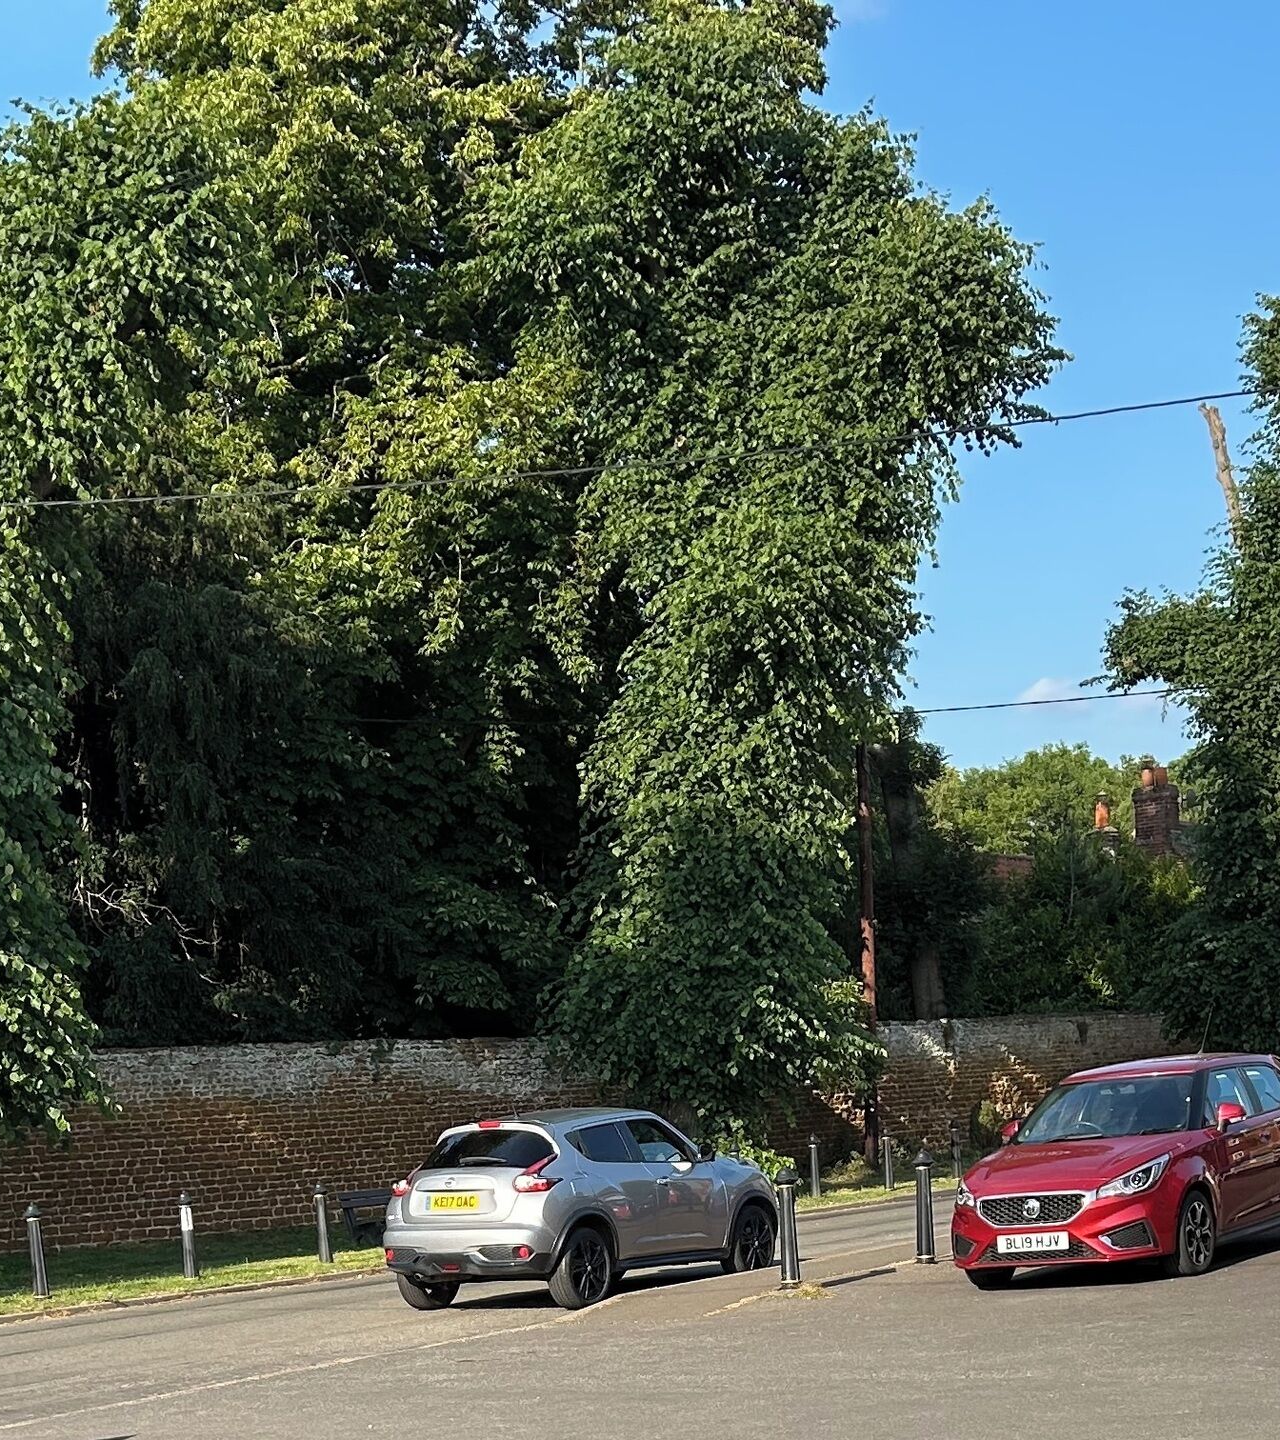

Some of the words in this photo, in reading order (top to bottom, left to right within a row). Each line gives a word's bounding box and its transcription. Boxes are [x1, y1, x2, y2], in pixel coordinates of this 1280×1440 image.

[433, 1196, 454, 1207] KE17
[1005, 1237, 1032, 1249] BL19
[1035, 1235, 1060, 1247] HJV
